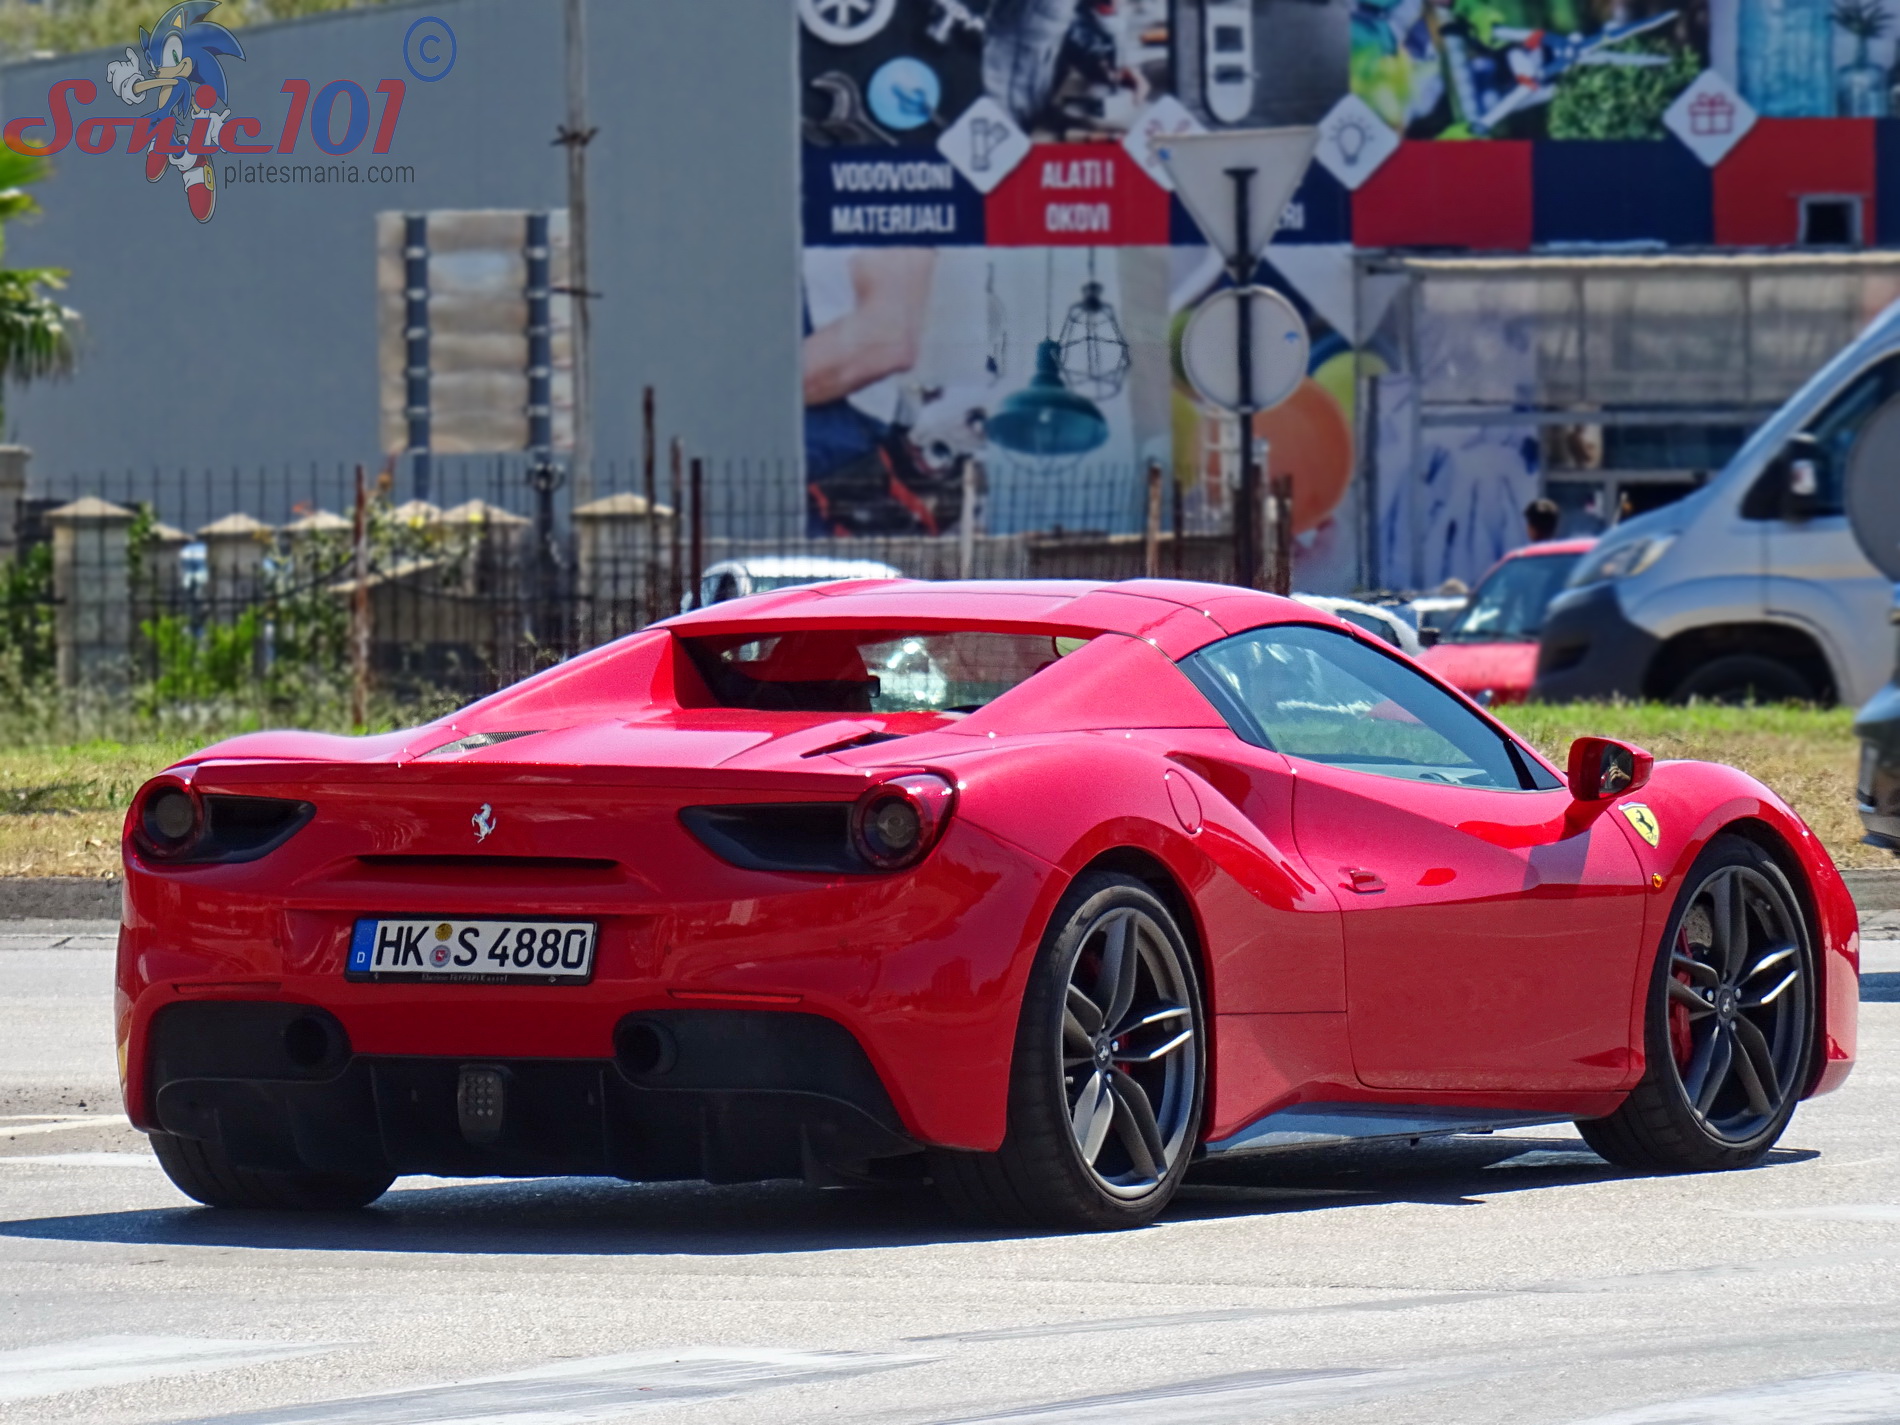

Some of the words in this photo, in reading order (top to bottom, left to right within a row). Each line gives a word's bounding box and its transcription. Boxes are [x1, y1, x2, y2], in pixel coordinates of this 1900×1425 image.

[831, 162, 953, 190] VODOVODNI
[1041, 161, 1101, 188] ALATI
[831, 205, 956, 233] MATERIJALI
[1045, 204, 1111, 232] OKOVI
[356, 952, 366, 963] D
[375, 926, 429, 966] HK
[454, 927, 479, 967] S
[487, 928, 587, 969] 4880
